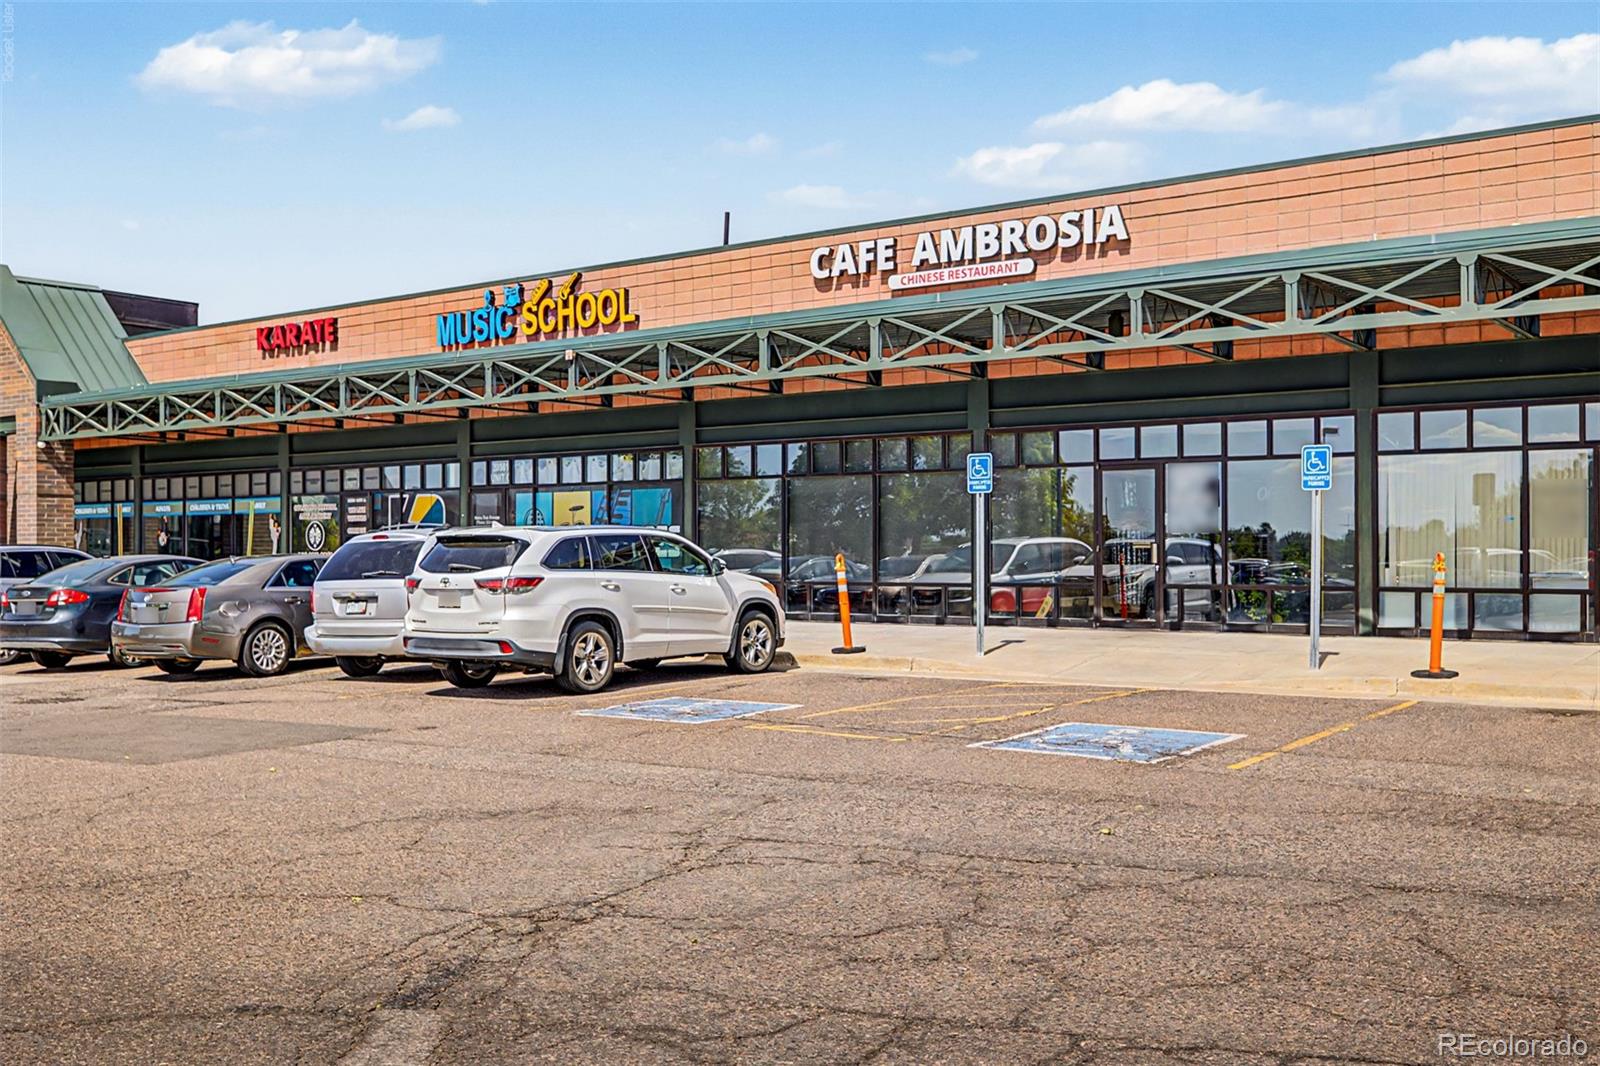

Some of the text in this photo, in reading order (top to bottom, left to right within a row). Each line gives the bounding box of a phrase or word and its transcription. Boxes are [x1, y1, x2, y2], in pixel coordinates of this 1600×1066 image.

[809, 204, 1129, 280] CAFE AMBROSIA
[900, 262, 1020, 286] CHINESE RESTAURANT
[256, 317, 336, 352] KARATE
[436, 287, 637, 347] MUSIC SCHOOL
